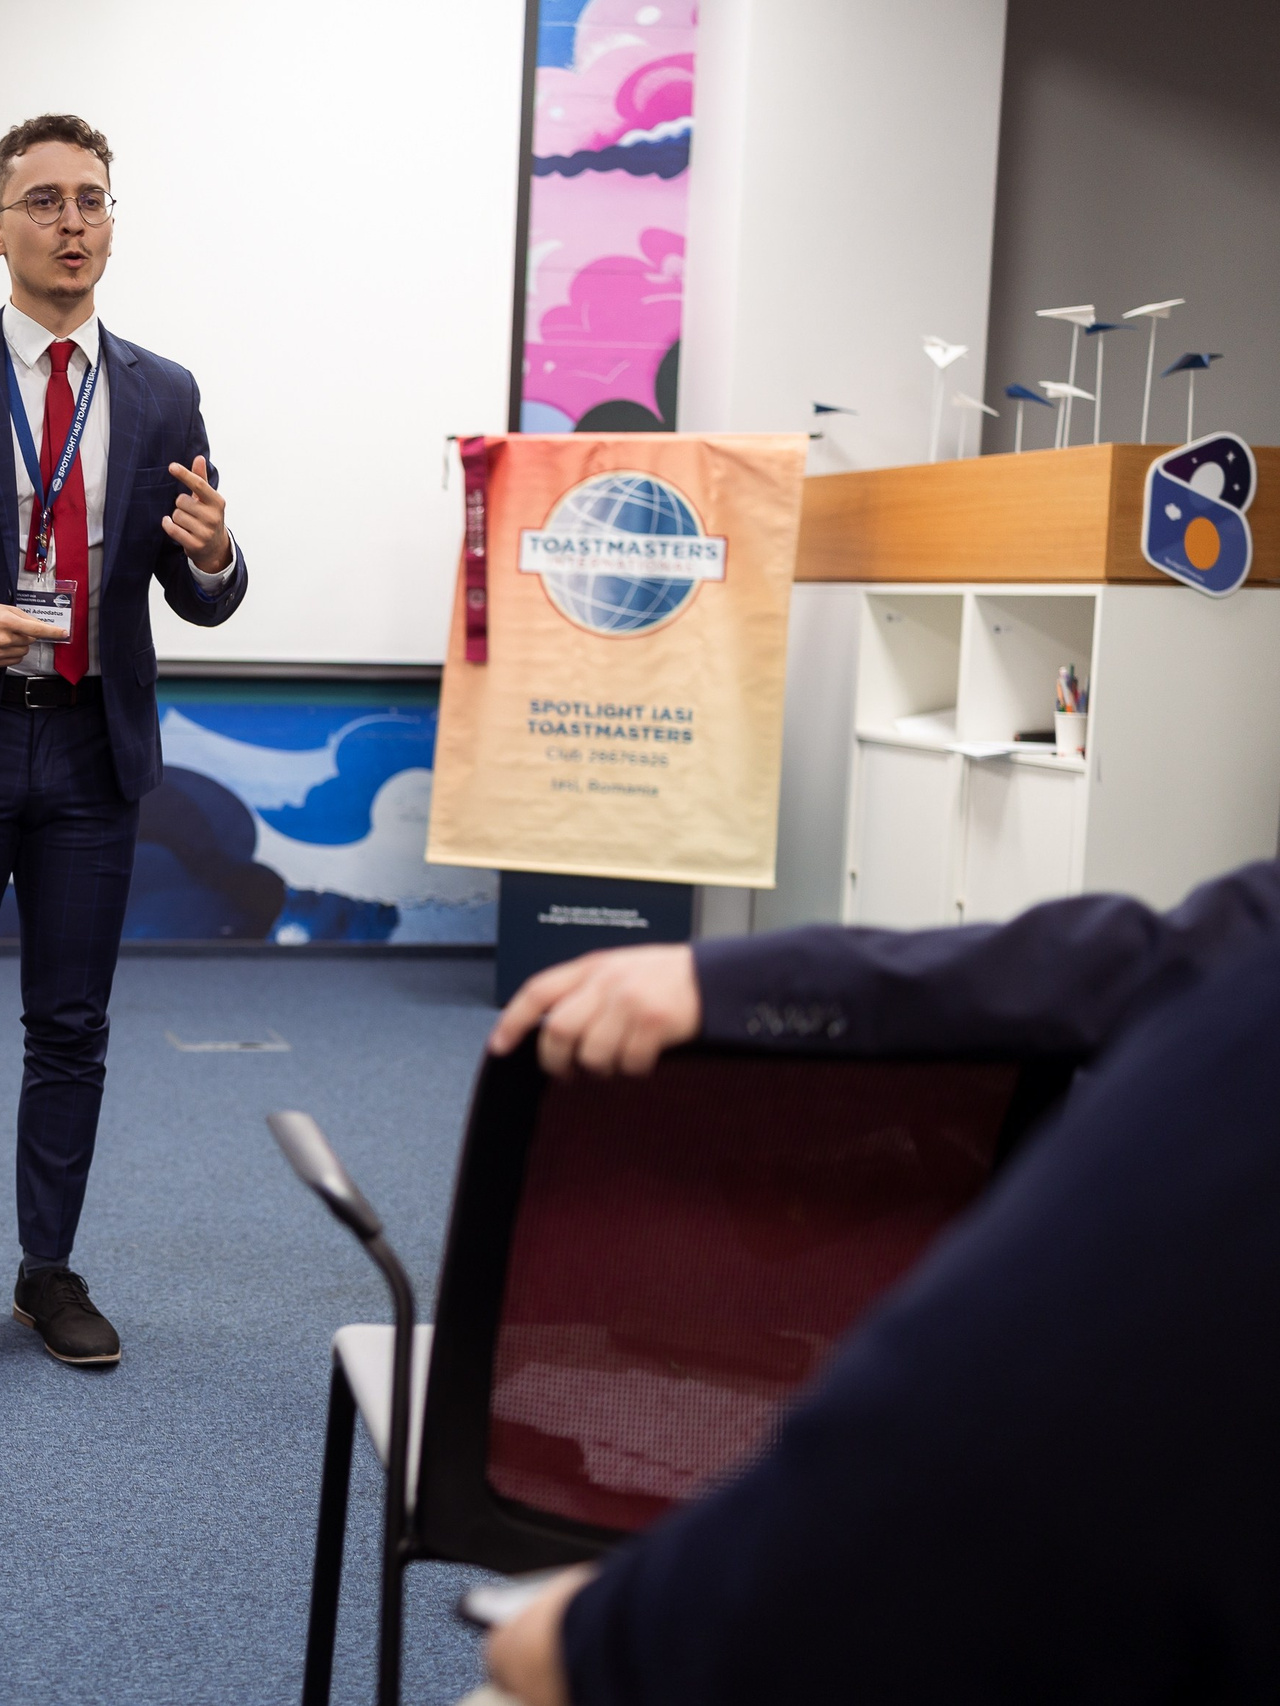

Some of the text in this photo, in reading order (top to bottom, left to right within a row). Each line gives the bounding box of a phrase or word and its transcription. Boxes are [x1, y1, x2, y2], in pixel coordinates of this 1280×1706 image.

[58, 436, 77, 477] SPOTLIGHT
[529, 535, 718, 560] TOASTMASTERS
[530, 700, 644, 719] SPOTLIGHT
[528, 720, 693, 743] TOASTMASTERS
[546, 746, 582, 763] Club
[588, 778, 660, 797] Romania
